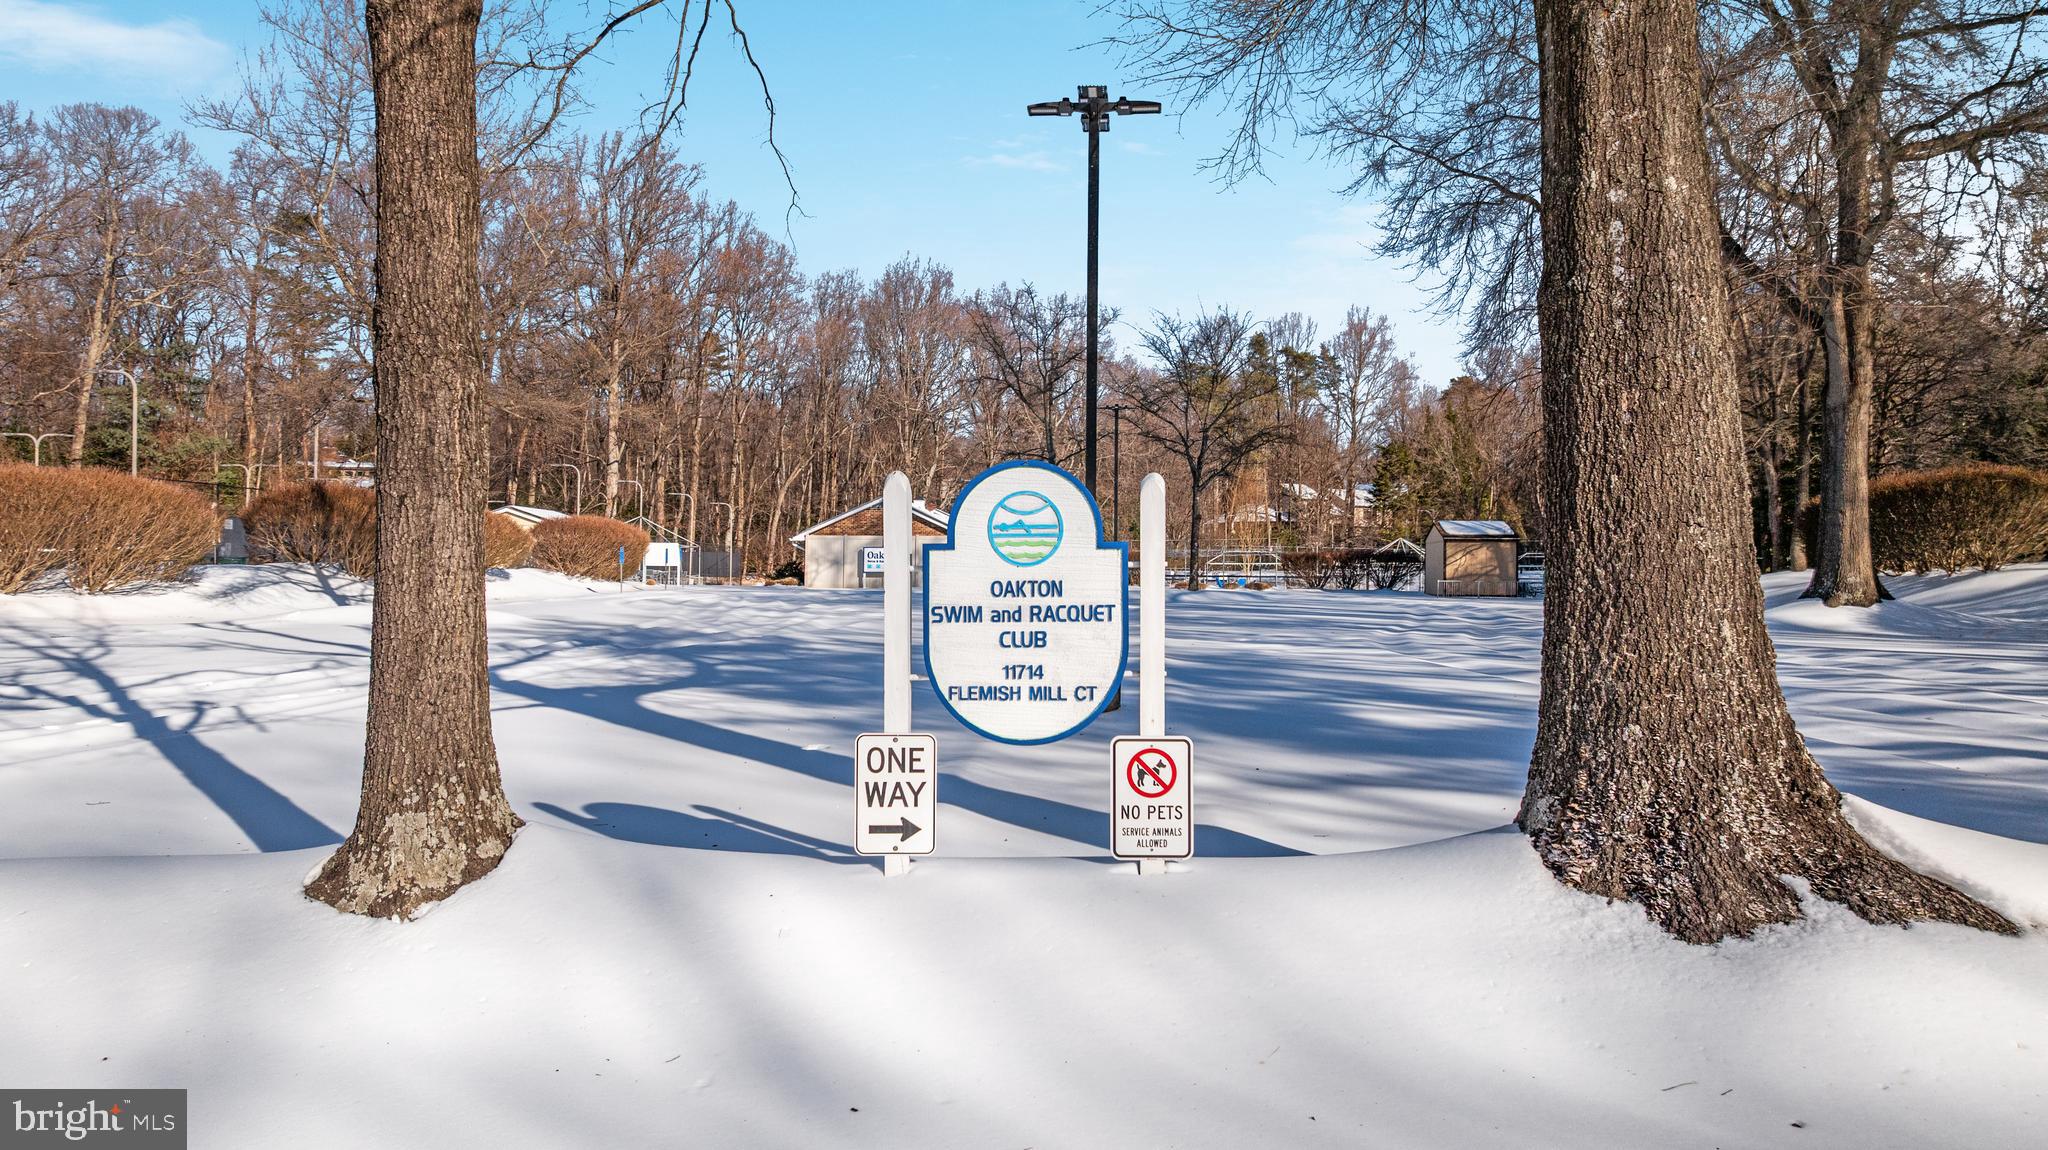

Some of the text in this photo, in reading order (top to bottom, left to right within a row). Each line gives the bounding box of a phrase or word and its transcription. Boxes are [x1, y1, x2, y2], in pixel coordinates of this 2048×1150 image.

[990, 580, 1063, 598] OAKTON
[931, 604, 1116, 624] SWIM and RACQUET
[999, 631, 1047, 648] CLUB
[1002, 665, 1044, 680] 11714
[948, 686, 1097, 701] FLEMISH MILL CT
[866, 747, 925, 774] ONE
[864, 781, 927, 808] WAY
[1121, 805, 1184, 821] NO PETS
[1121, 828, 1183, 837] SERVICE ANIMALS
[1136, 839, 1168, 848] ALLOWED
